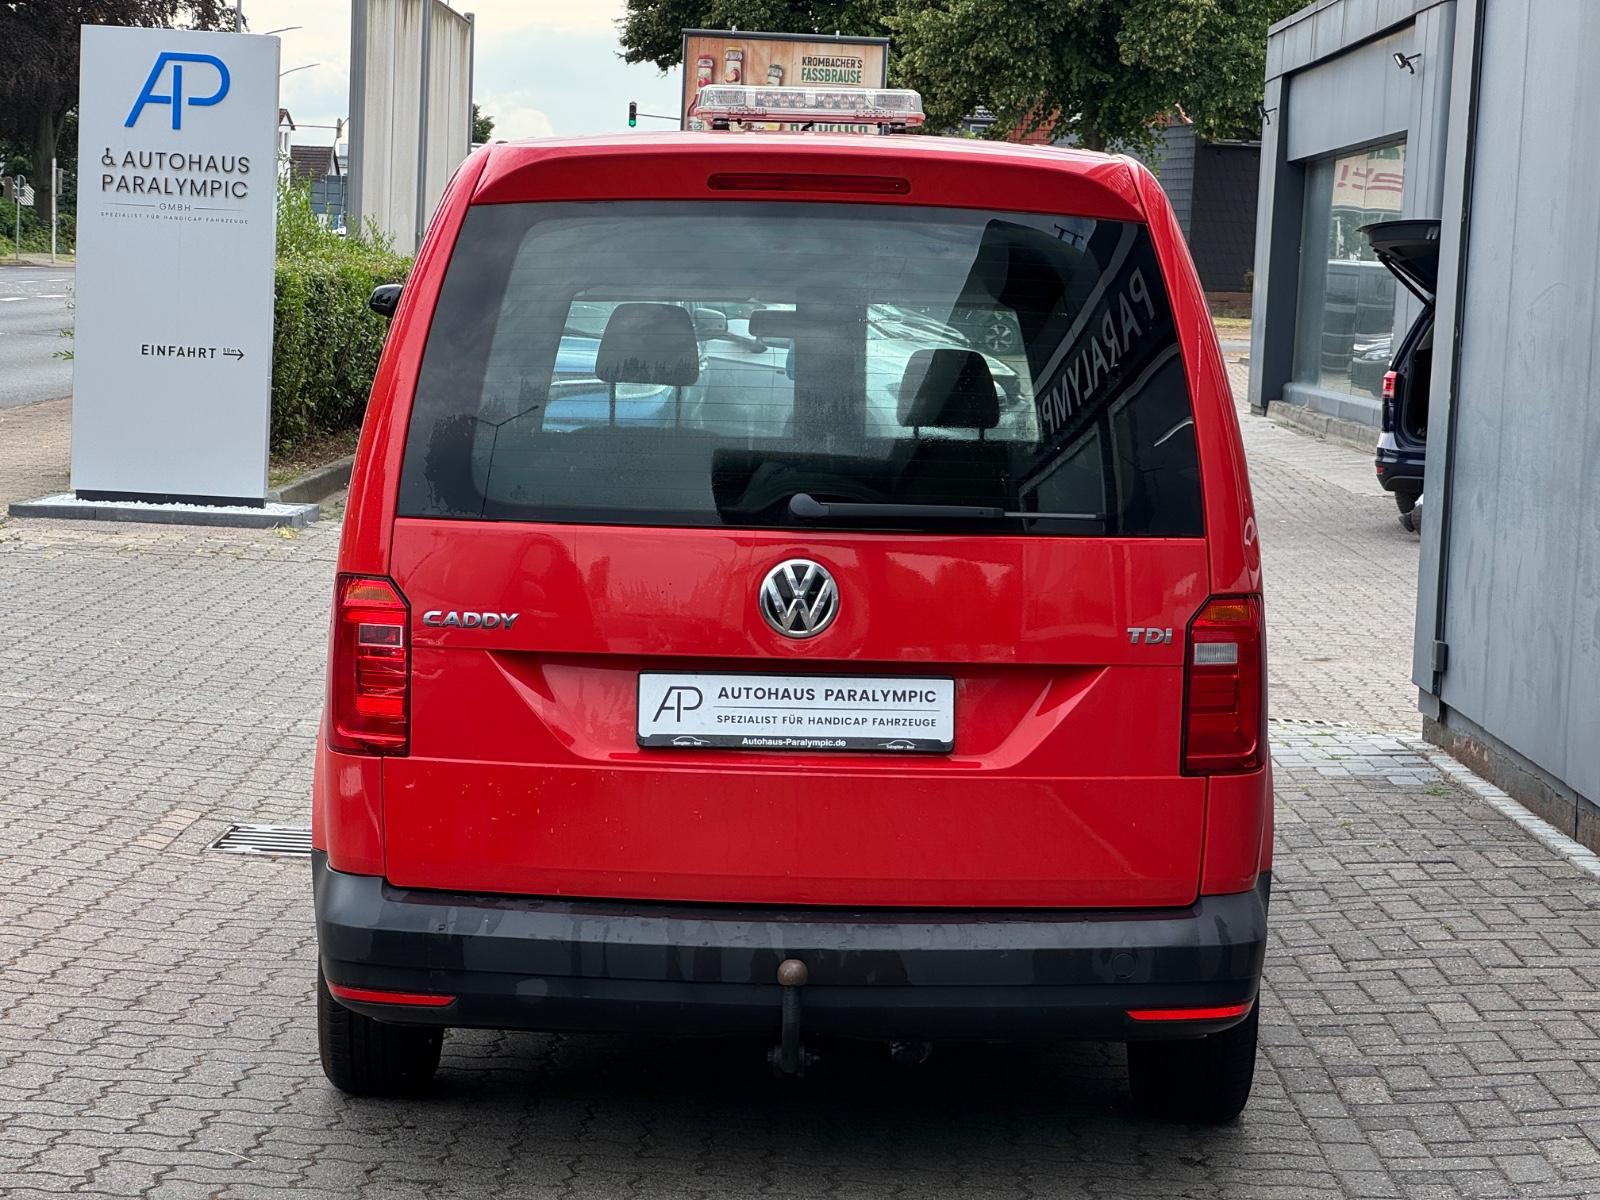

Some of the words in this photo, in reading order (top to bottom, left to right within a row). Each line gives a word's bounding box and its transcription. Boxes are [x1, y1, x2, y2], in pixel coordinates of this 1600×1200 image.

[801, 56, 863, 69] KROMBACHER'S
[801, 67, 862, 84] FASSBRAUSE
[122, 151, 250, 174] AUTOHAUS
[102, 174, 249, 199] PARALYMPIC
[159, 202, 192, 212] GMBH
[141, 344, 217, 359] EINFAHRT
[423, 610, 519, 630] CADDY
[1127, 627, 1173, 644] TDI
[718, 686, 816, 701] AUTOHAUS
[824, 688, 937, 703] PARALYMPIC
[716, 715, 778, 725] SPEZIALIST
[782, 714, 803, 725] FÜR
[808, 716, 868, 726] HANDICAP
[872, 718, 937, 727] FAHRZEUGE
[742, 737, 847, 748] Autohaus-Paralympic.de
